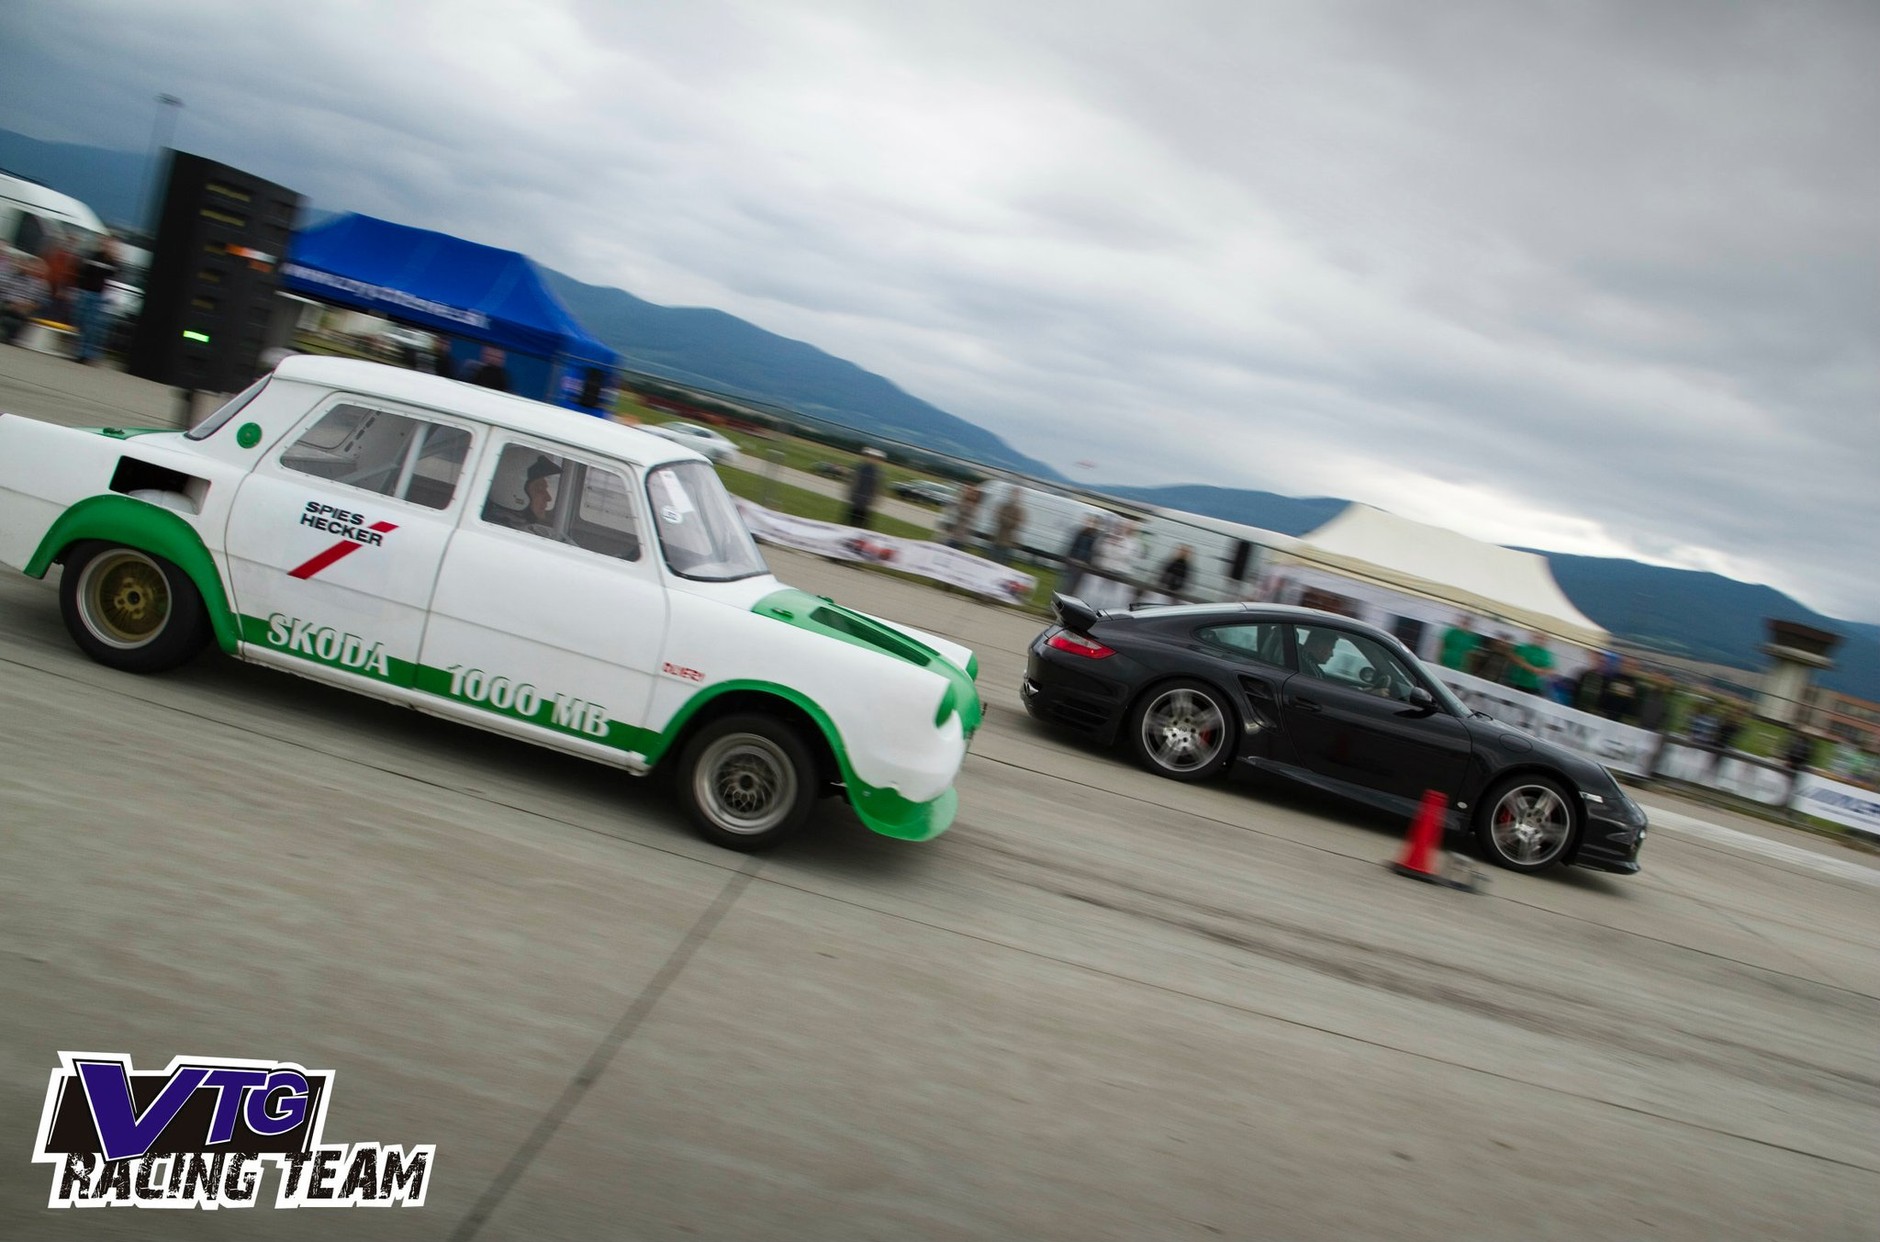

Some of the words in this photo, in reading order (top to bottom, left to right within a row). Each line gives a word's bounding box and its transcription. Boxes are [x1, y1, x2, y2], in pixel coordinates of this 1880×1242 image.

[300, 513, 383, 547] HECKER
[305, 501, 365, 526] SPIES
[267, 612, 389, 677] SKODA
[447, 664, 542, 717] 1000
[551, 692, 610, 738] MB
